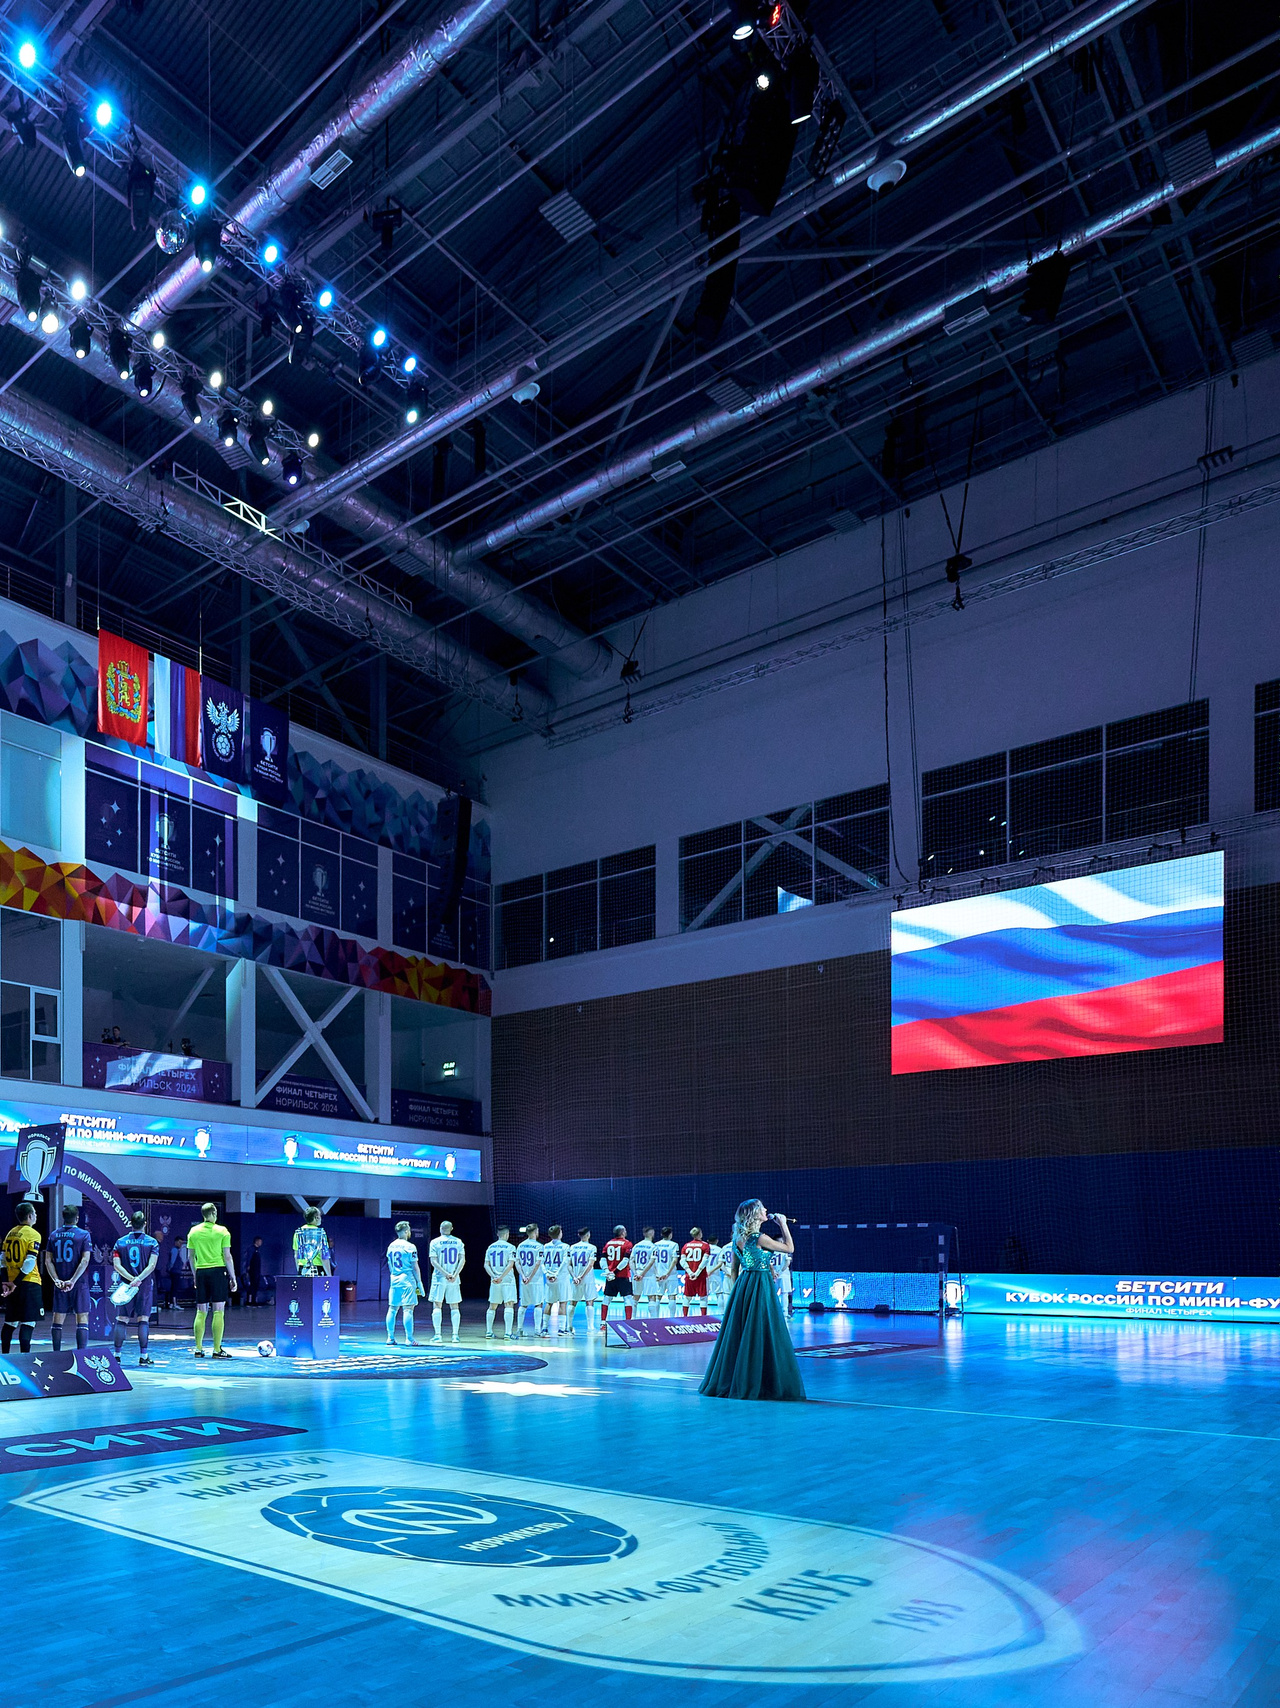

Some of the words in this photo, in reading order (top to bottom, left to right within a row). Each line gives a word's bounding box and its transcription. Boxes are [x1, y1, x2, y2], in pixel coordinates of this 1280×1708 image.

[175, 1082, 197, 1094] 2024
[275, 1085, 303, 1097] ФИНАЛ
[304, 1089, 339, 1102] ЧЕТЫРЕХ
[275, 1096, 320, 1111] НОРИЛЬСК
[321, 1102, 339, 1113] 2024
[76, 1129, 93, 1139] ПО
[93, 1130, 174, 1146] МИНИ-ФУТБОЛУ
[63, 1164, 78, 1177] ПО
[77, 1170, 132, 1229] МИНИ-ФУТБОЛУ
[5, 1239, 21, 1263] 30
[54, 1239, 74, 1263] 16
[128, 1245, 140, 1268] 9
[441, 1247, 458, 1265] 10
[490, 1250, 504, 1267] 11
[520, 1250, 535, 1267] 99
[544, 1251, 562, 1267] 44
[571, 1251, 588, 1267] 14
[606, 1246, 622, 1261] 91
[635, 1250, 648, 1265] 18
[685, 1247, 703, 1262] 20
[388, 1251, 403, 1269] 13
[1115, 1280, 1224, 1295] БЕТСИТИ
[1005, 1292, 1065, 1304] КУБОК
[1067, 1293, 1144, 1306] РОССИИ
[1147, 1295, 1176, 1307] ПО
[1125, 1307, 1162, 1315] ФИНАЛ
[1164, 1308, 1213, 1316] ЧЕТЫРЕХ
[81, 1455, 335, 1501] НОРИЛЬСКИЙ
[177, 1471, 329, 1500] НИКЕЛЬ
[457, 1521, 569, 1553] НОРНИКЕЛЬ
[492, 1520, 772, 1608] МИНИ-ФУТБОЛЬНЫЙ
[732, 1569, 874, 1622] КЛУБ
